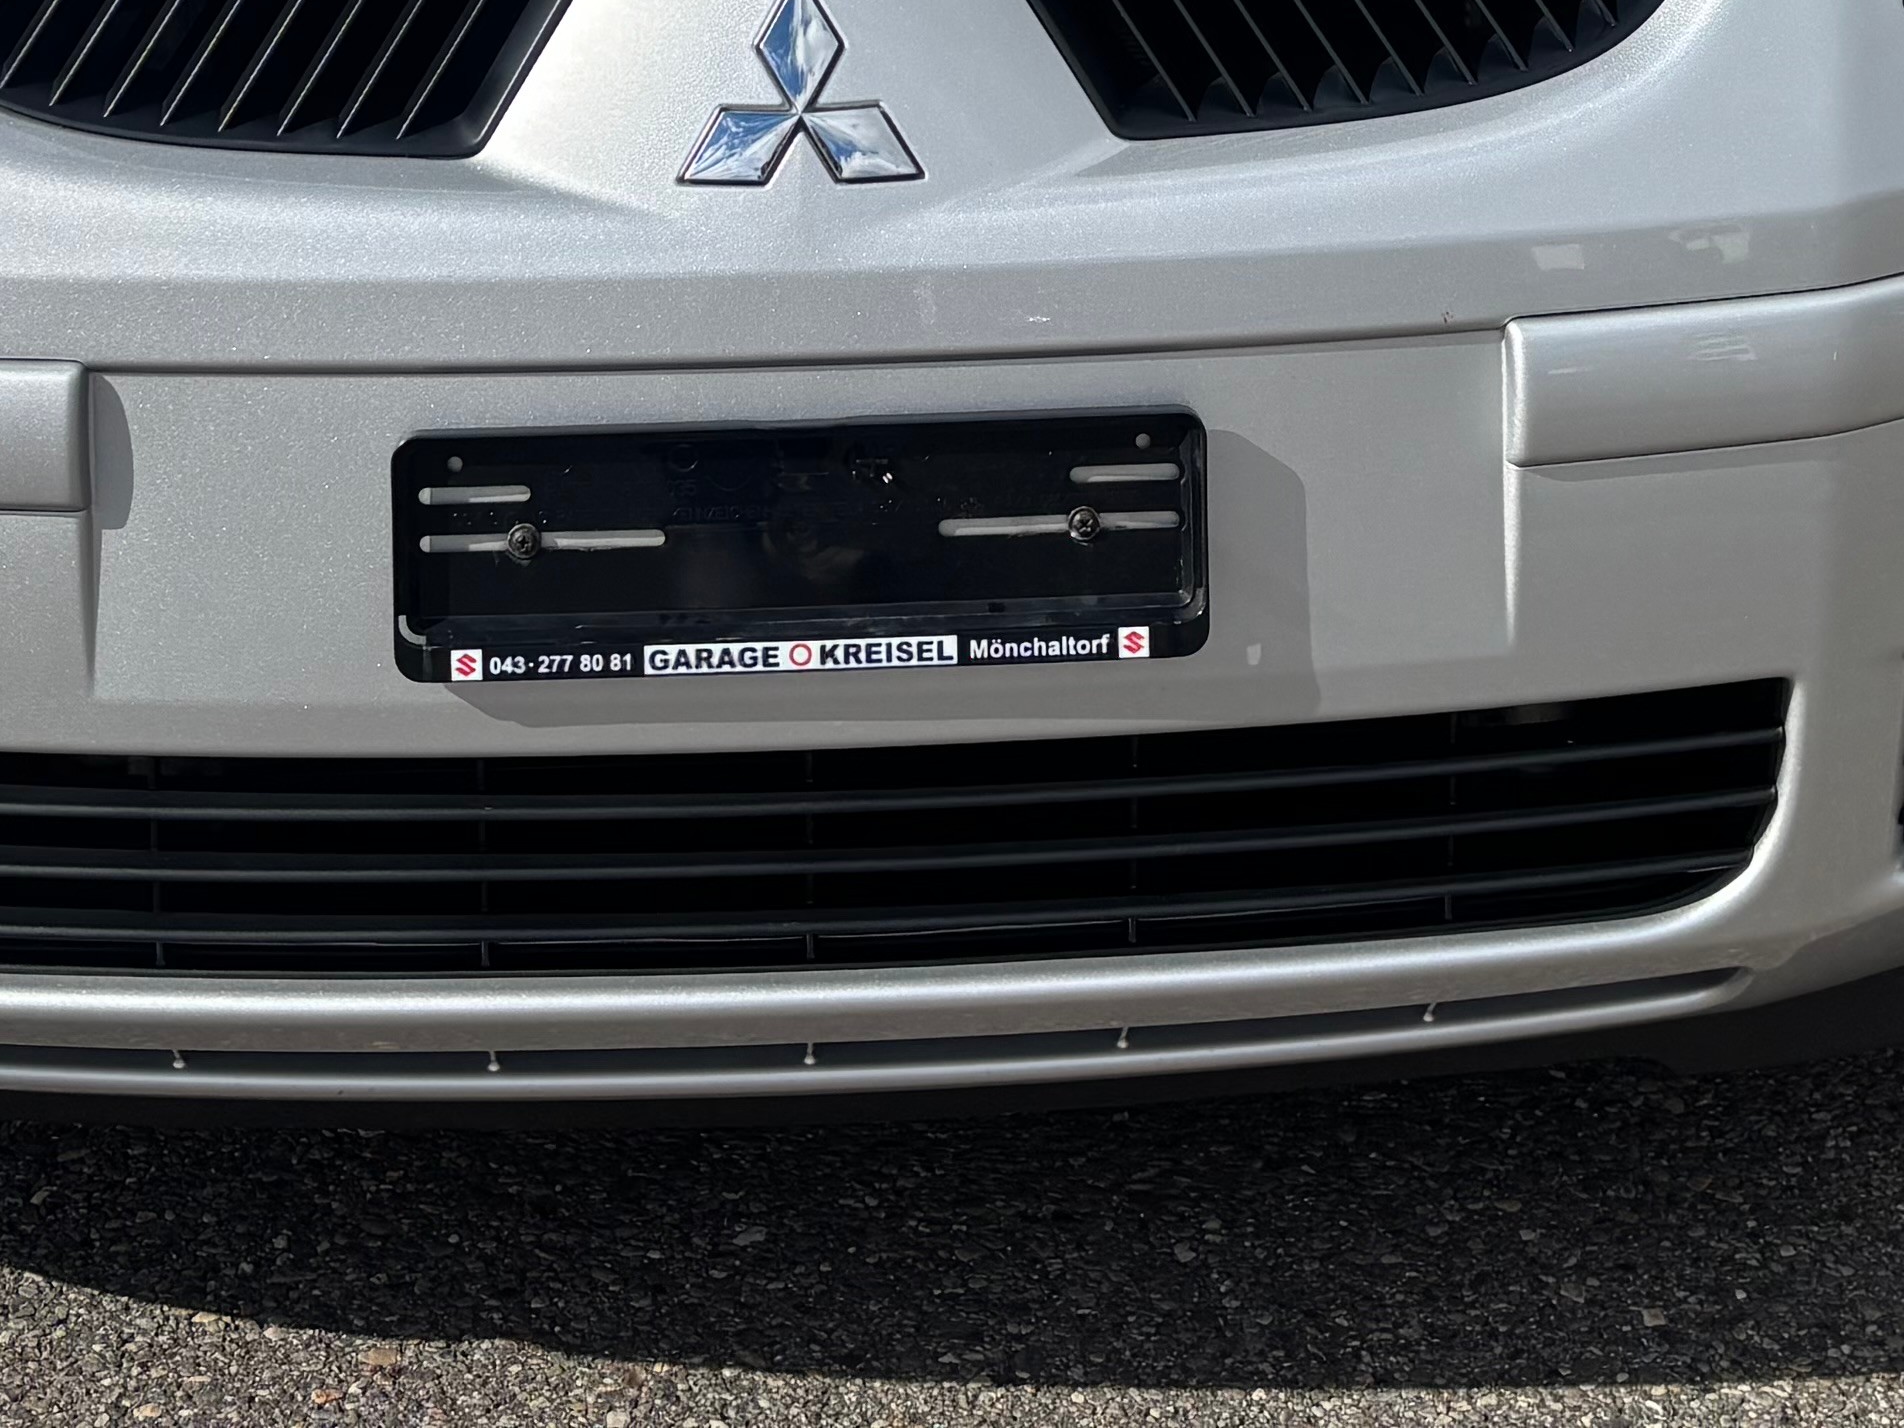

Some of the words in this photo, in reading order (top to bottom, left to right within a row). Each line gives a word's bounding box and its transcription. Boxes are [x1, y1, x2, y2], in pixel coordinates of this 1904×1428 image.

[579, 654, 604, 672] 80
[609, 653, 632, 671] 81
[648, 646, 781, 671] GARAGE
[819, 640, 954, 665] KREISEL
[969, 634, 1110, 659] Mönchaltorf
